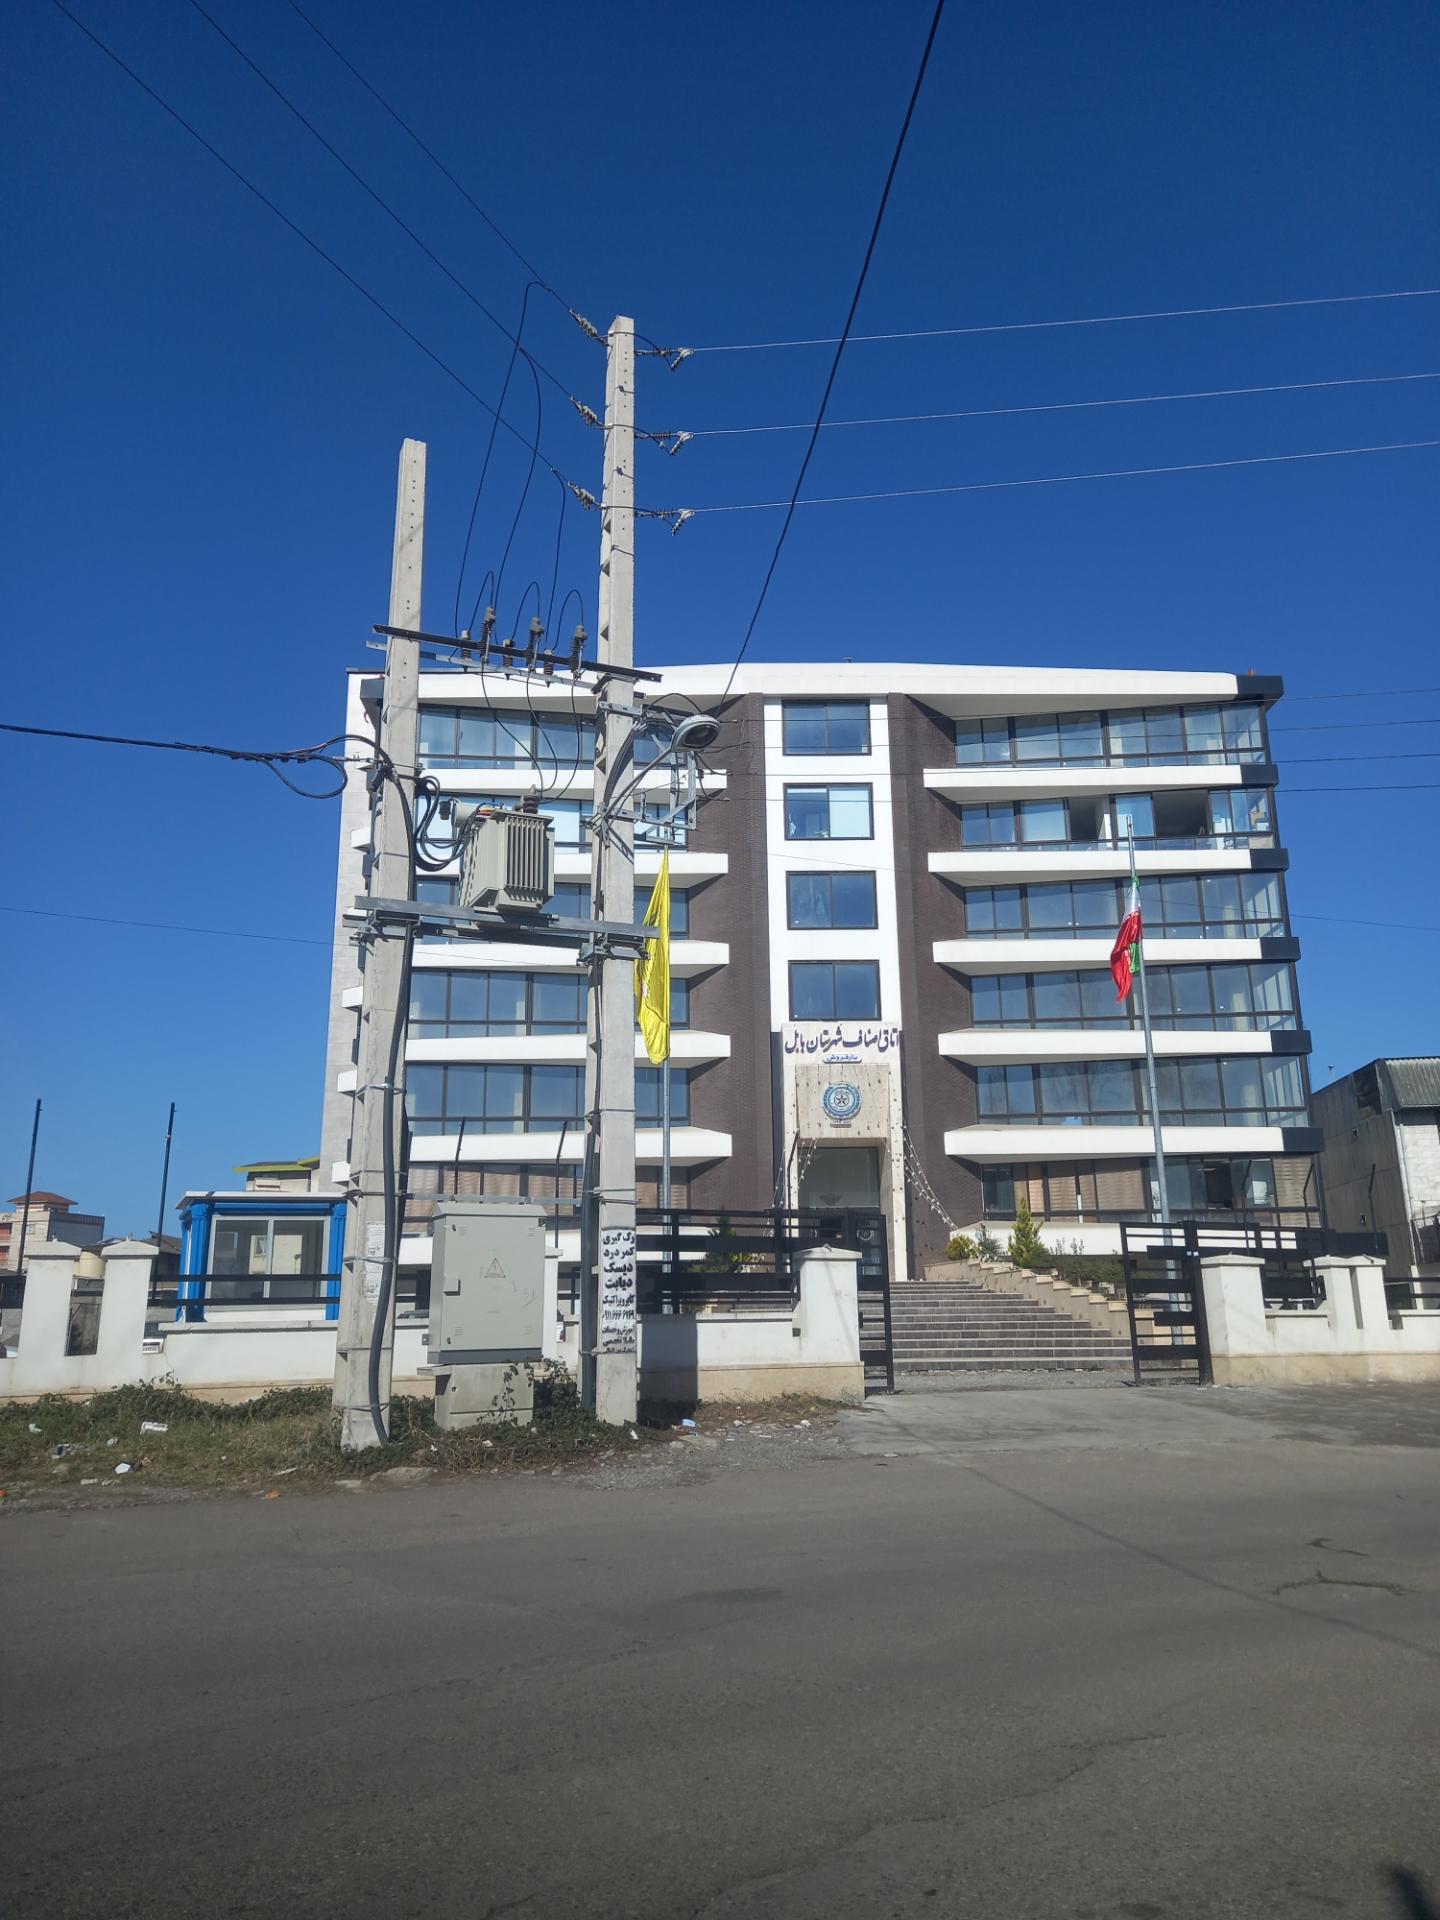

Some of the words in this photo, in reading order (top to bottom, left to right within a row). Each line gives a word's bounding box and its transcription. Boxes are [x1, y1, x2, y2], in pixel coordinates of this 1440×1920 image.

[784, 1026, 805, 1054] بابل
[805, 1023, 843, 1053] شهرستان
[842, 1028, 882, 1048] اصناف
[878, 1027, 900, 1053] اتاق
[603, 1249, 620, 1260] درد
[620, 1246, 635, 1259] کمر
[603, 1262, 634, 1276] دیسک
[604, 1276, 633, 1291] دیابت
